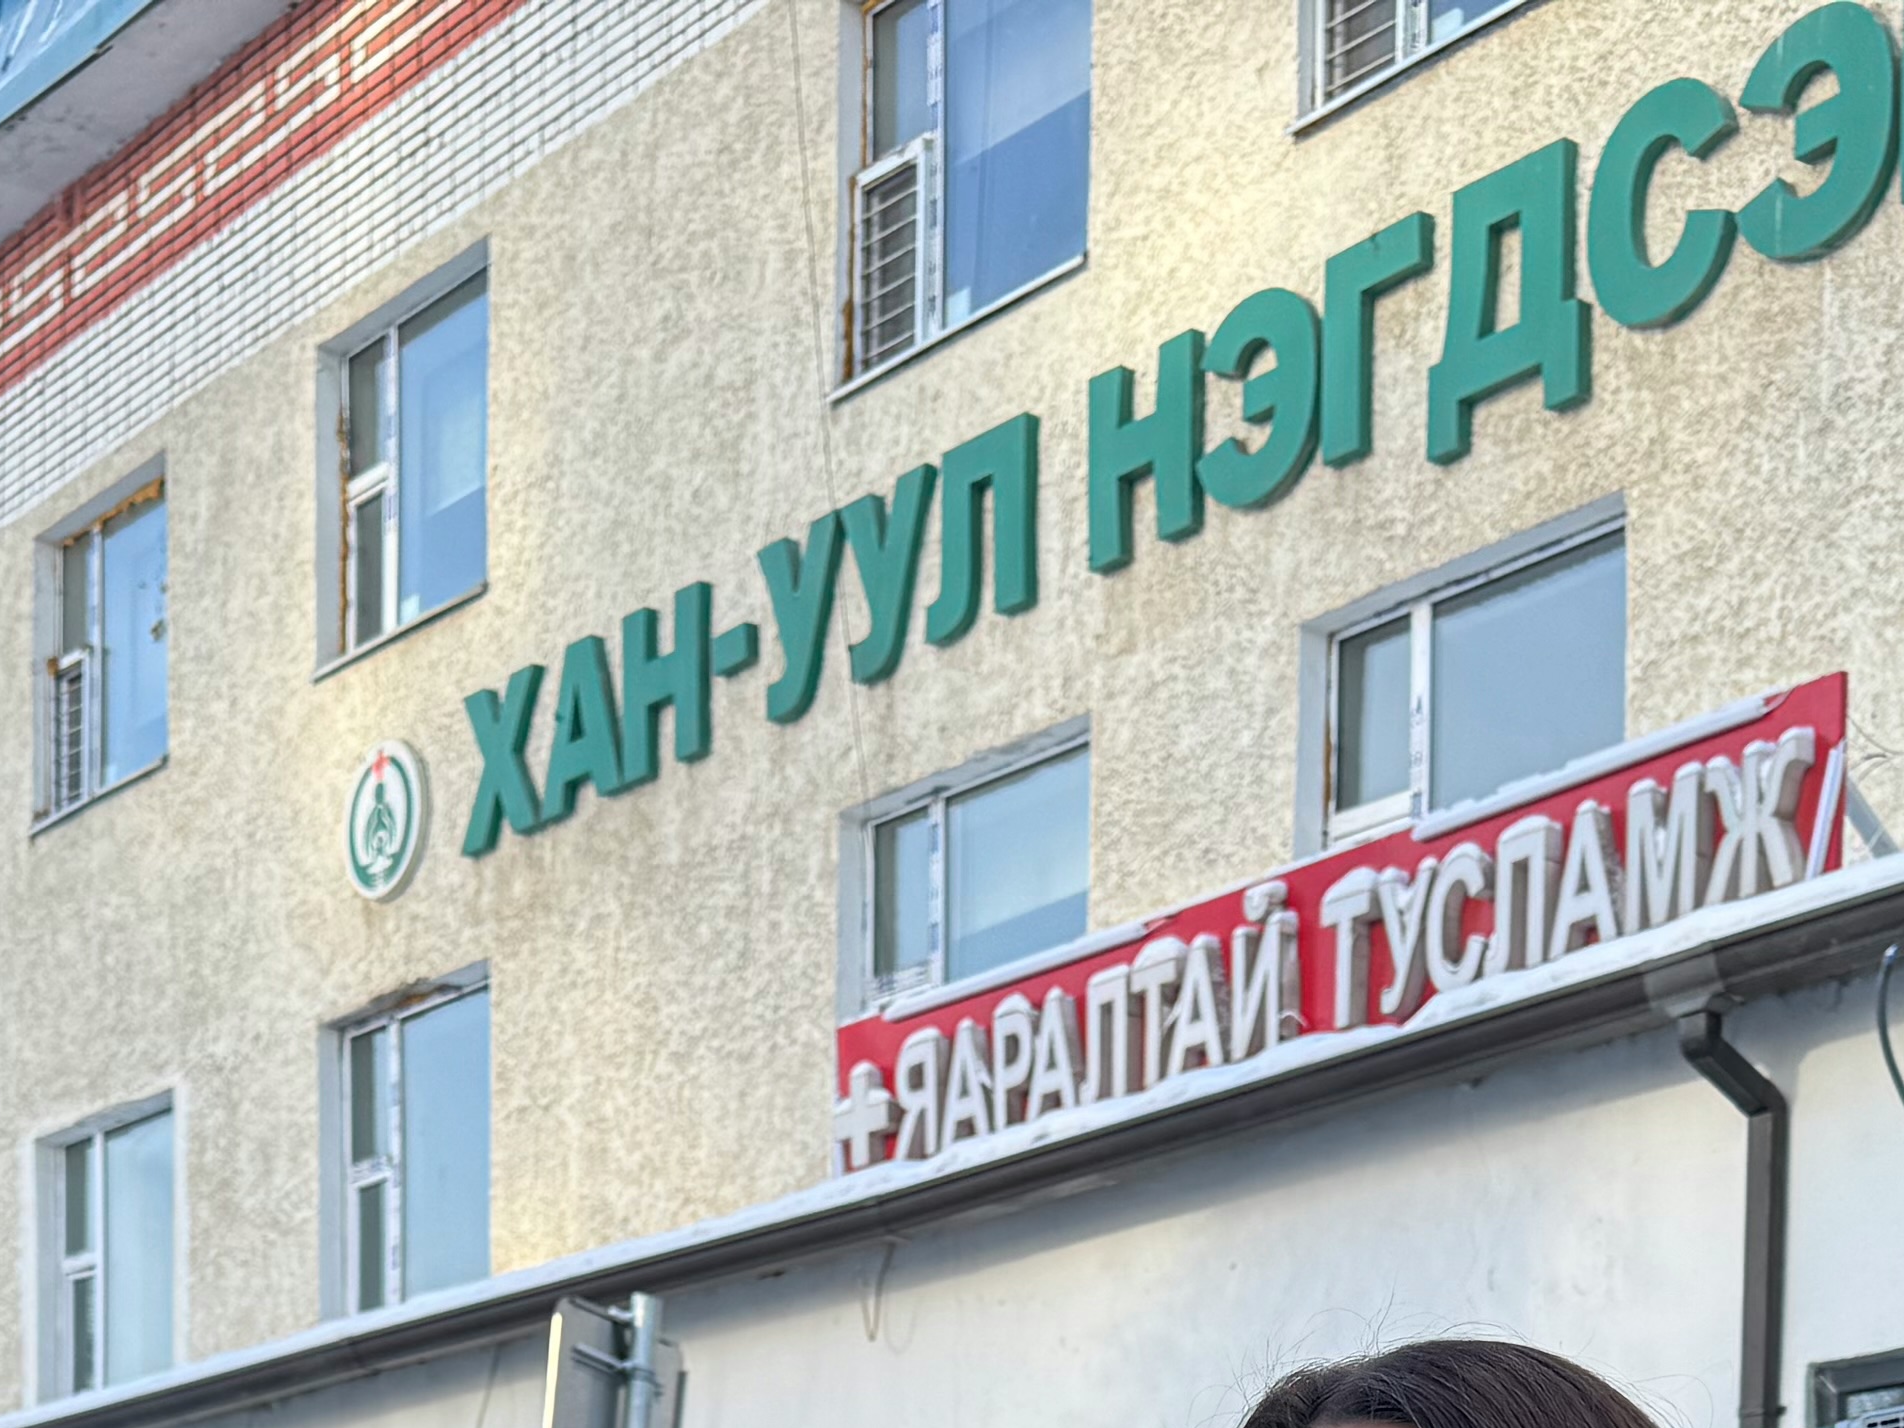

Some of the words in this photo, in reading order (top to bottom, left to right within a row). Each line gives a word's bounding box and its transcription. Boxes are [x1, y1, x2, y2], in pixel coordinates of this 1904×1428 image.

[461, 411, 1040, 860] ХАН-УУЛ
[894, 882, 1299, 1162] ЯАРАЛТАЙ
[1318, 726, 1815, 1029] ТУСЛАМЖ
